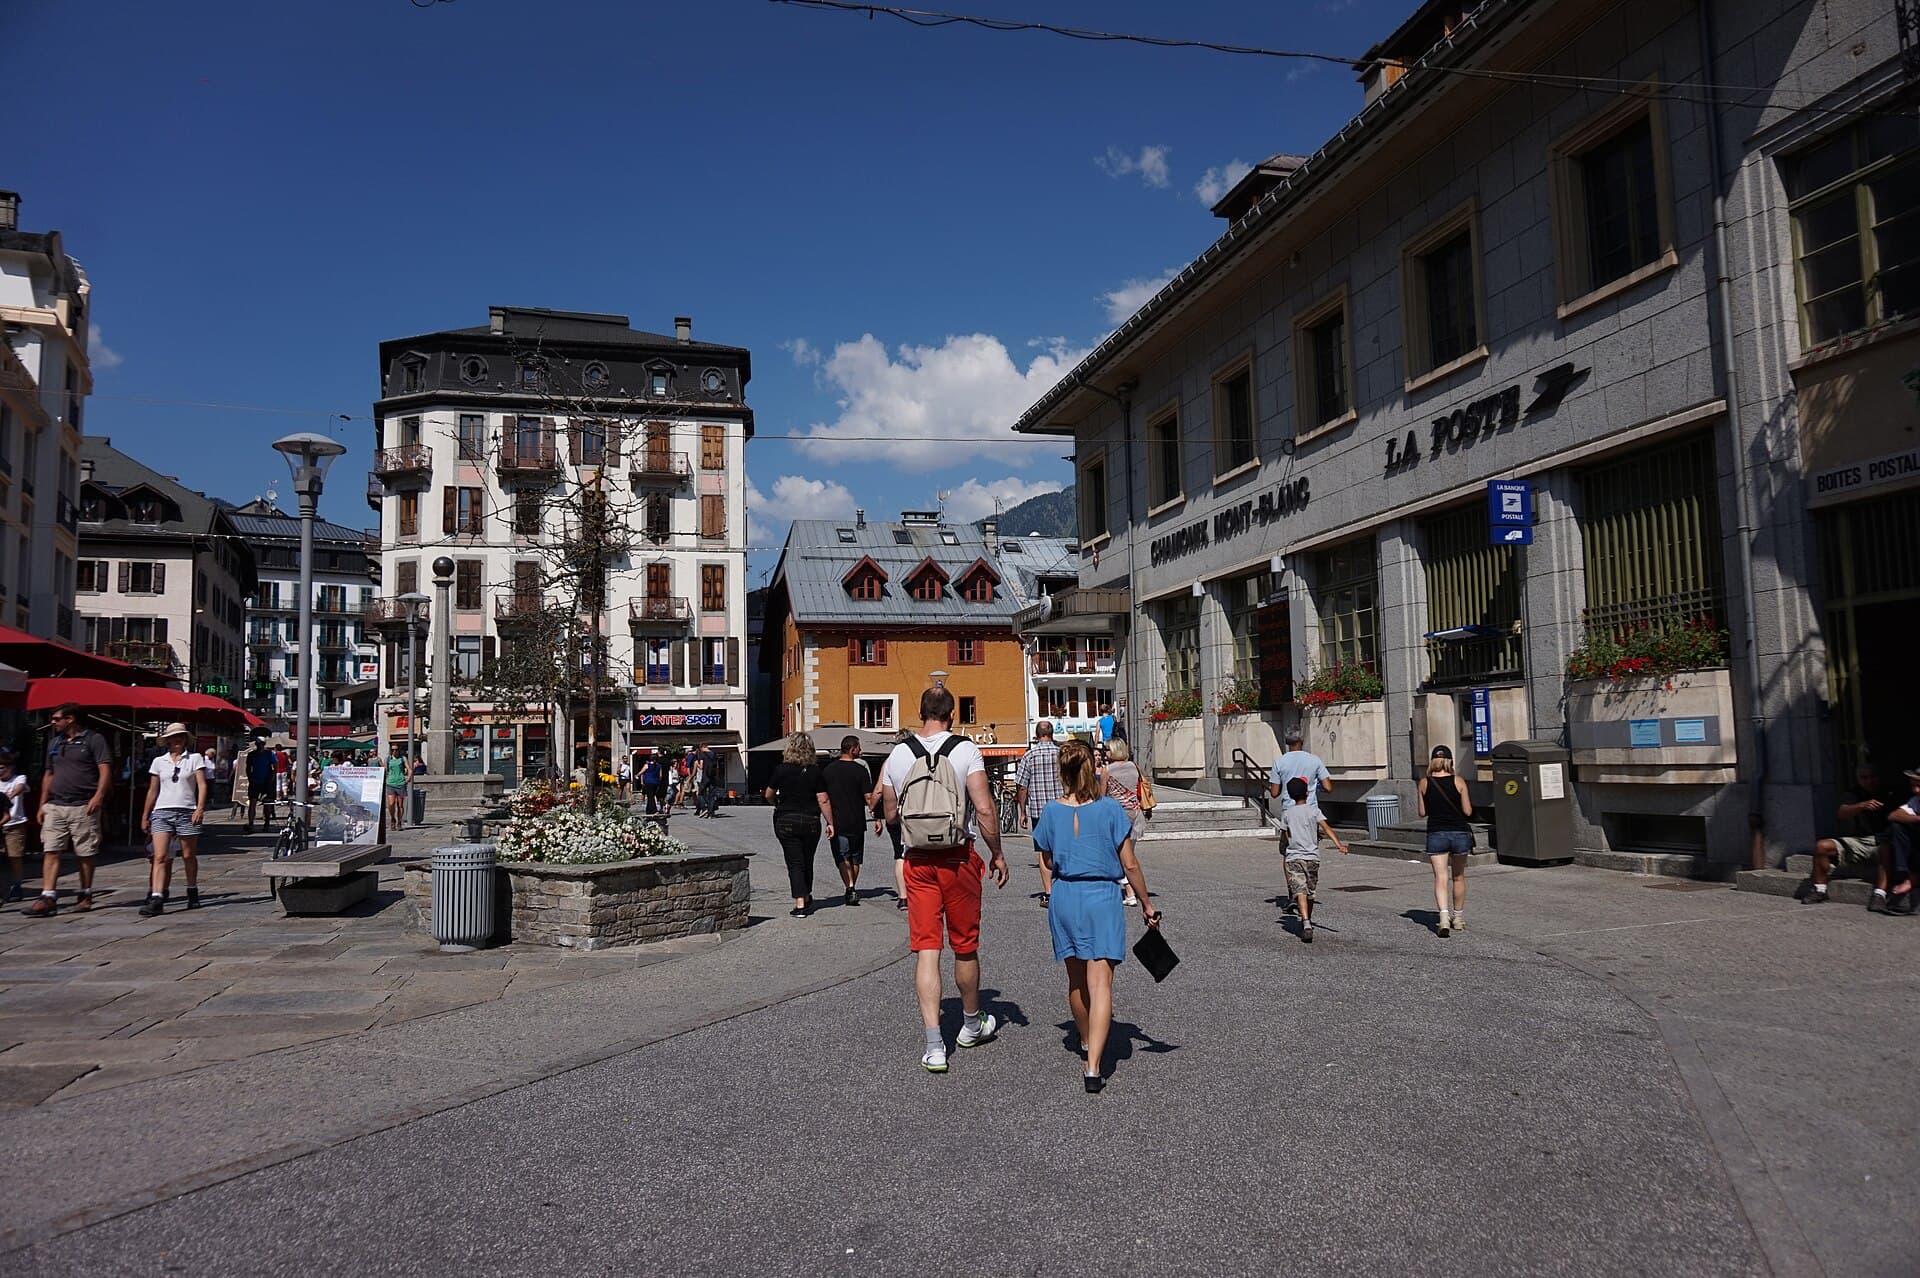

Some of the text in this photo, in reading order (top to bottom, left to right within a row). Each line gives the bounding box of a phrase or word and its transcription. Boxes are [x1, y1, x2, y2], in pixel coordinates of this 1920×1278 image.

[1384, 385, 1521, 474] LA POSTE
[1817, 467, 1862, 493] BOITES
[1150, 476, 1311, 568] CHAMONIX MONT-BLANC
[206, 684, 229, 694] 16:11
[652, 714, 721, 726] INTERSPORT
